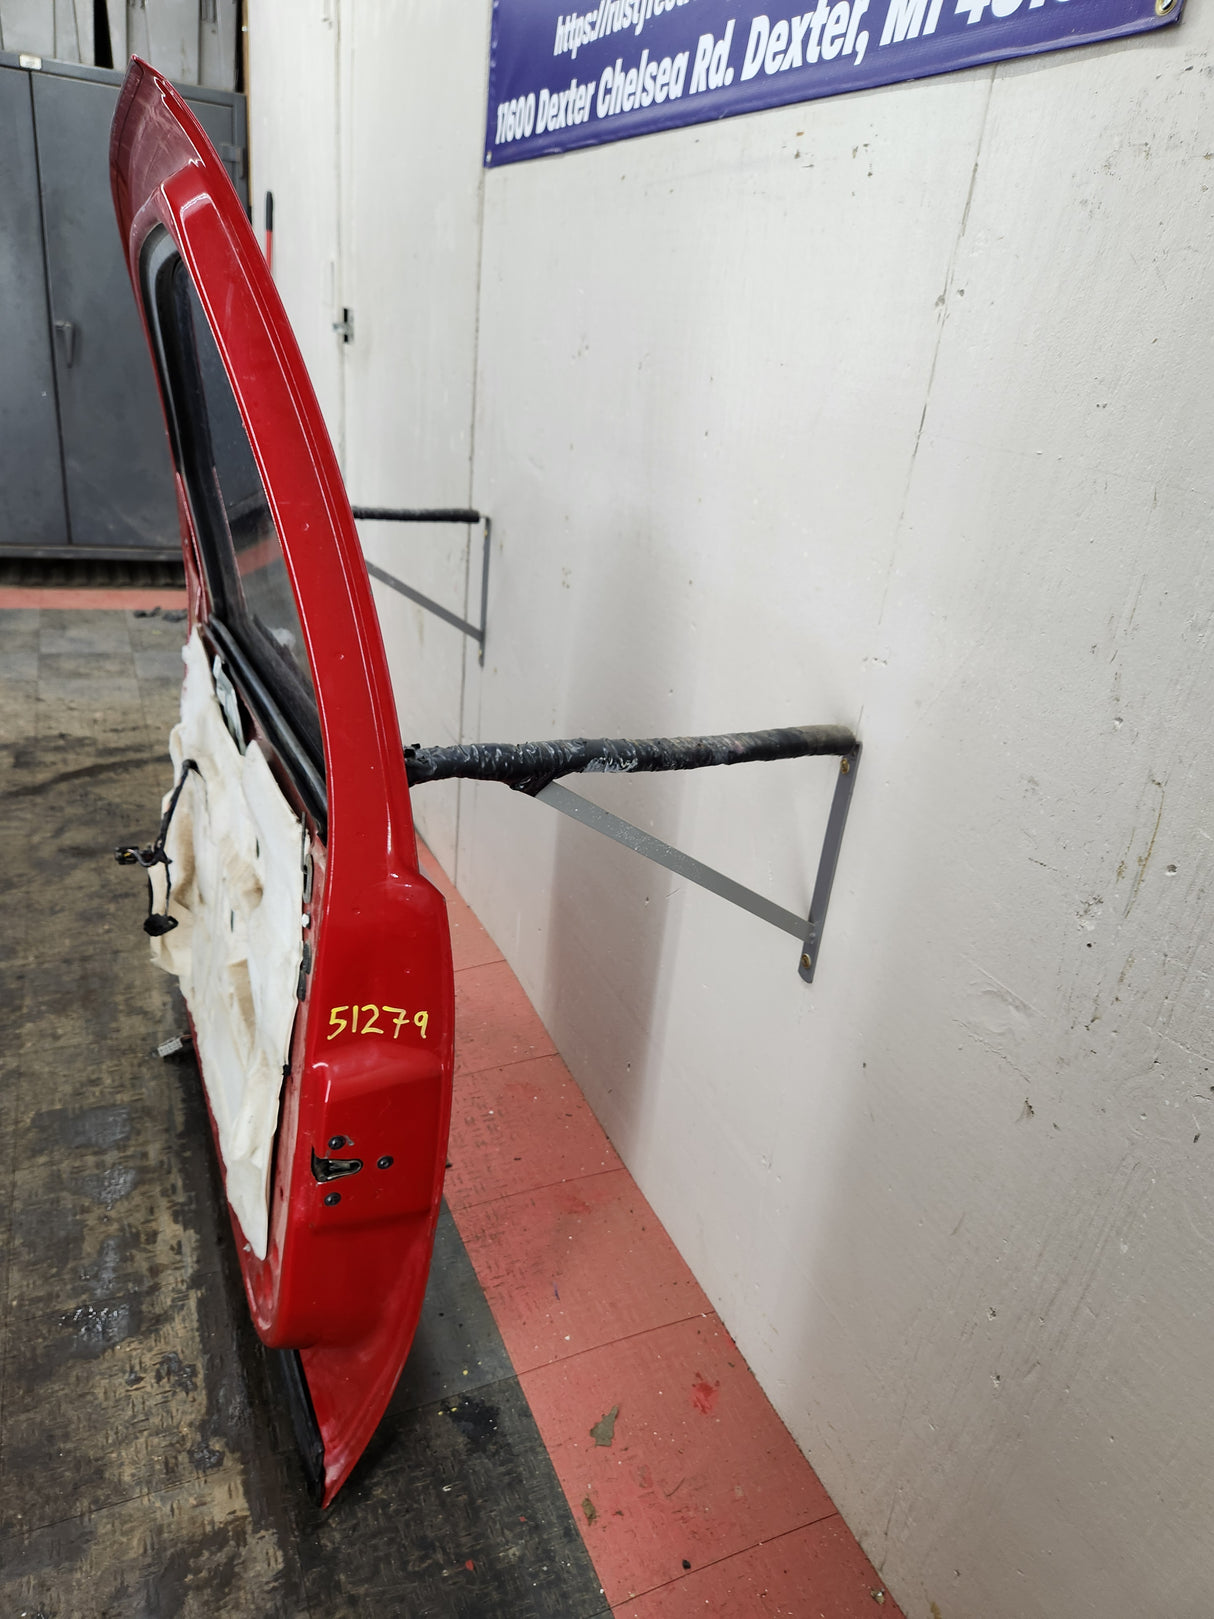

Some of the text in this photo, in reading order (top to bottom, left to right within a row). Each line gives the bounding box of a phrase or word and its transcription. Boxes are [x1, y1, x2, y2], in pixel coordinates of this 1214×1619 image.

[494, 92, 536, 145] 11600
[535, 78, 597, 135] Dexter
[596, 48, 690, 119] Chelsea
[689, 18, 735, 95] Rd.
[740, 0, 870, 82] Dexter,
[327, 1004, 429, 1040] 51279
